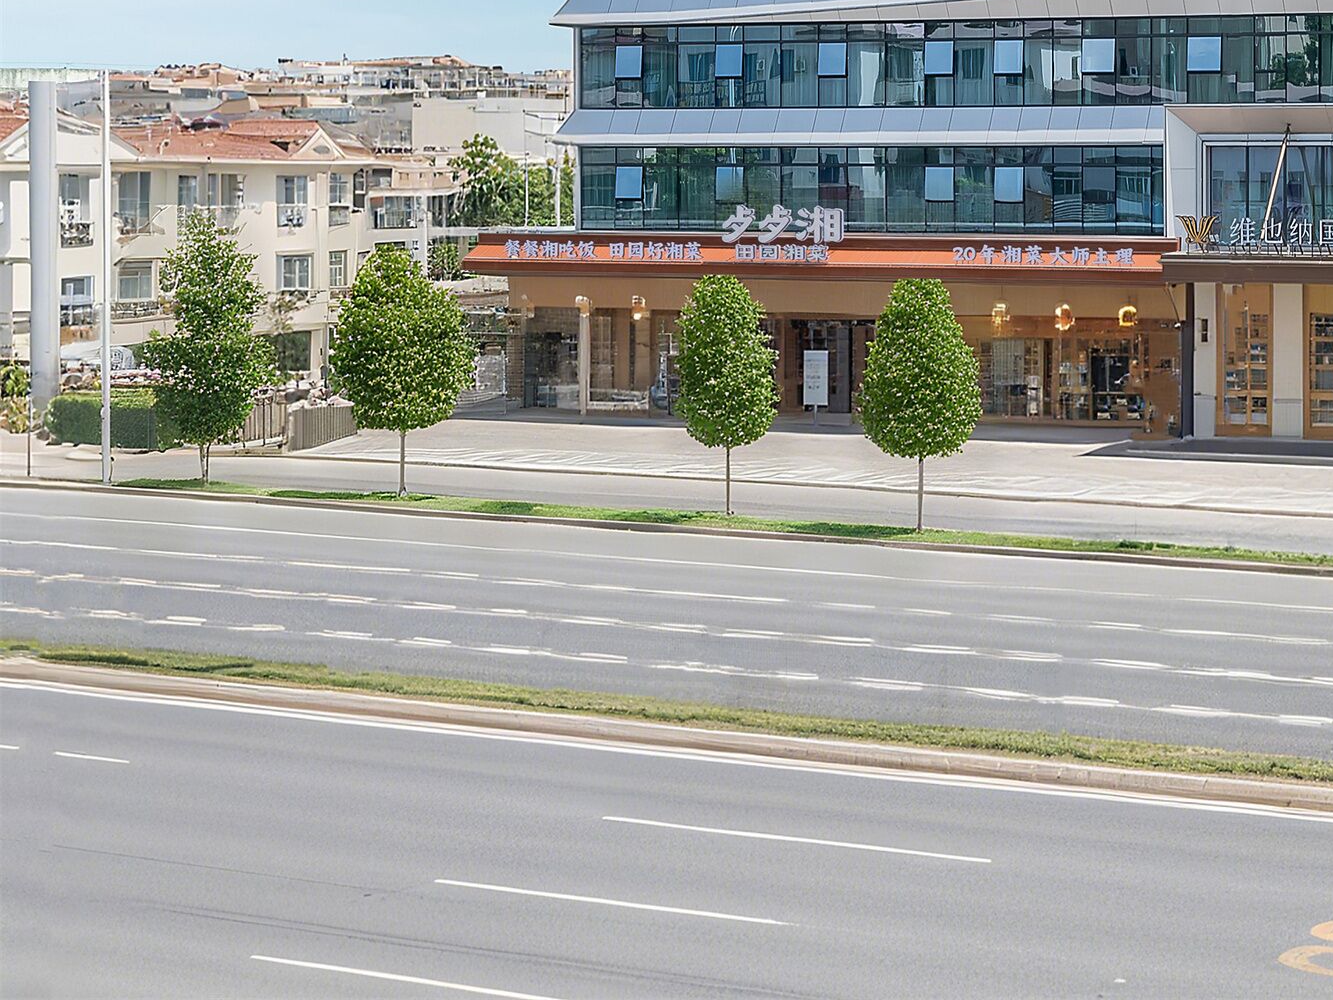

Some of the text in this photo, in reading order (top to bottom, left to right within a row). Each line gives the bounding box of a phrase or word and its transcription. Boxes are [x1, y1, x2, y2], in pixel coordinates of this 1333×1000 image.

[735, 244, 829, 262] 田园湘菜
[952, 244, 1135, 265] 20年湘菜大师主理
